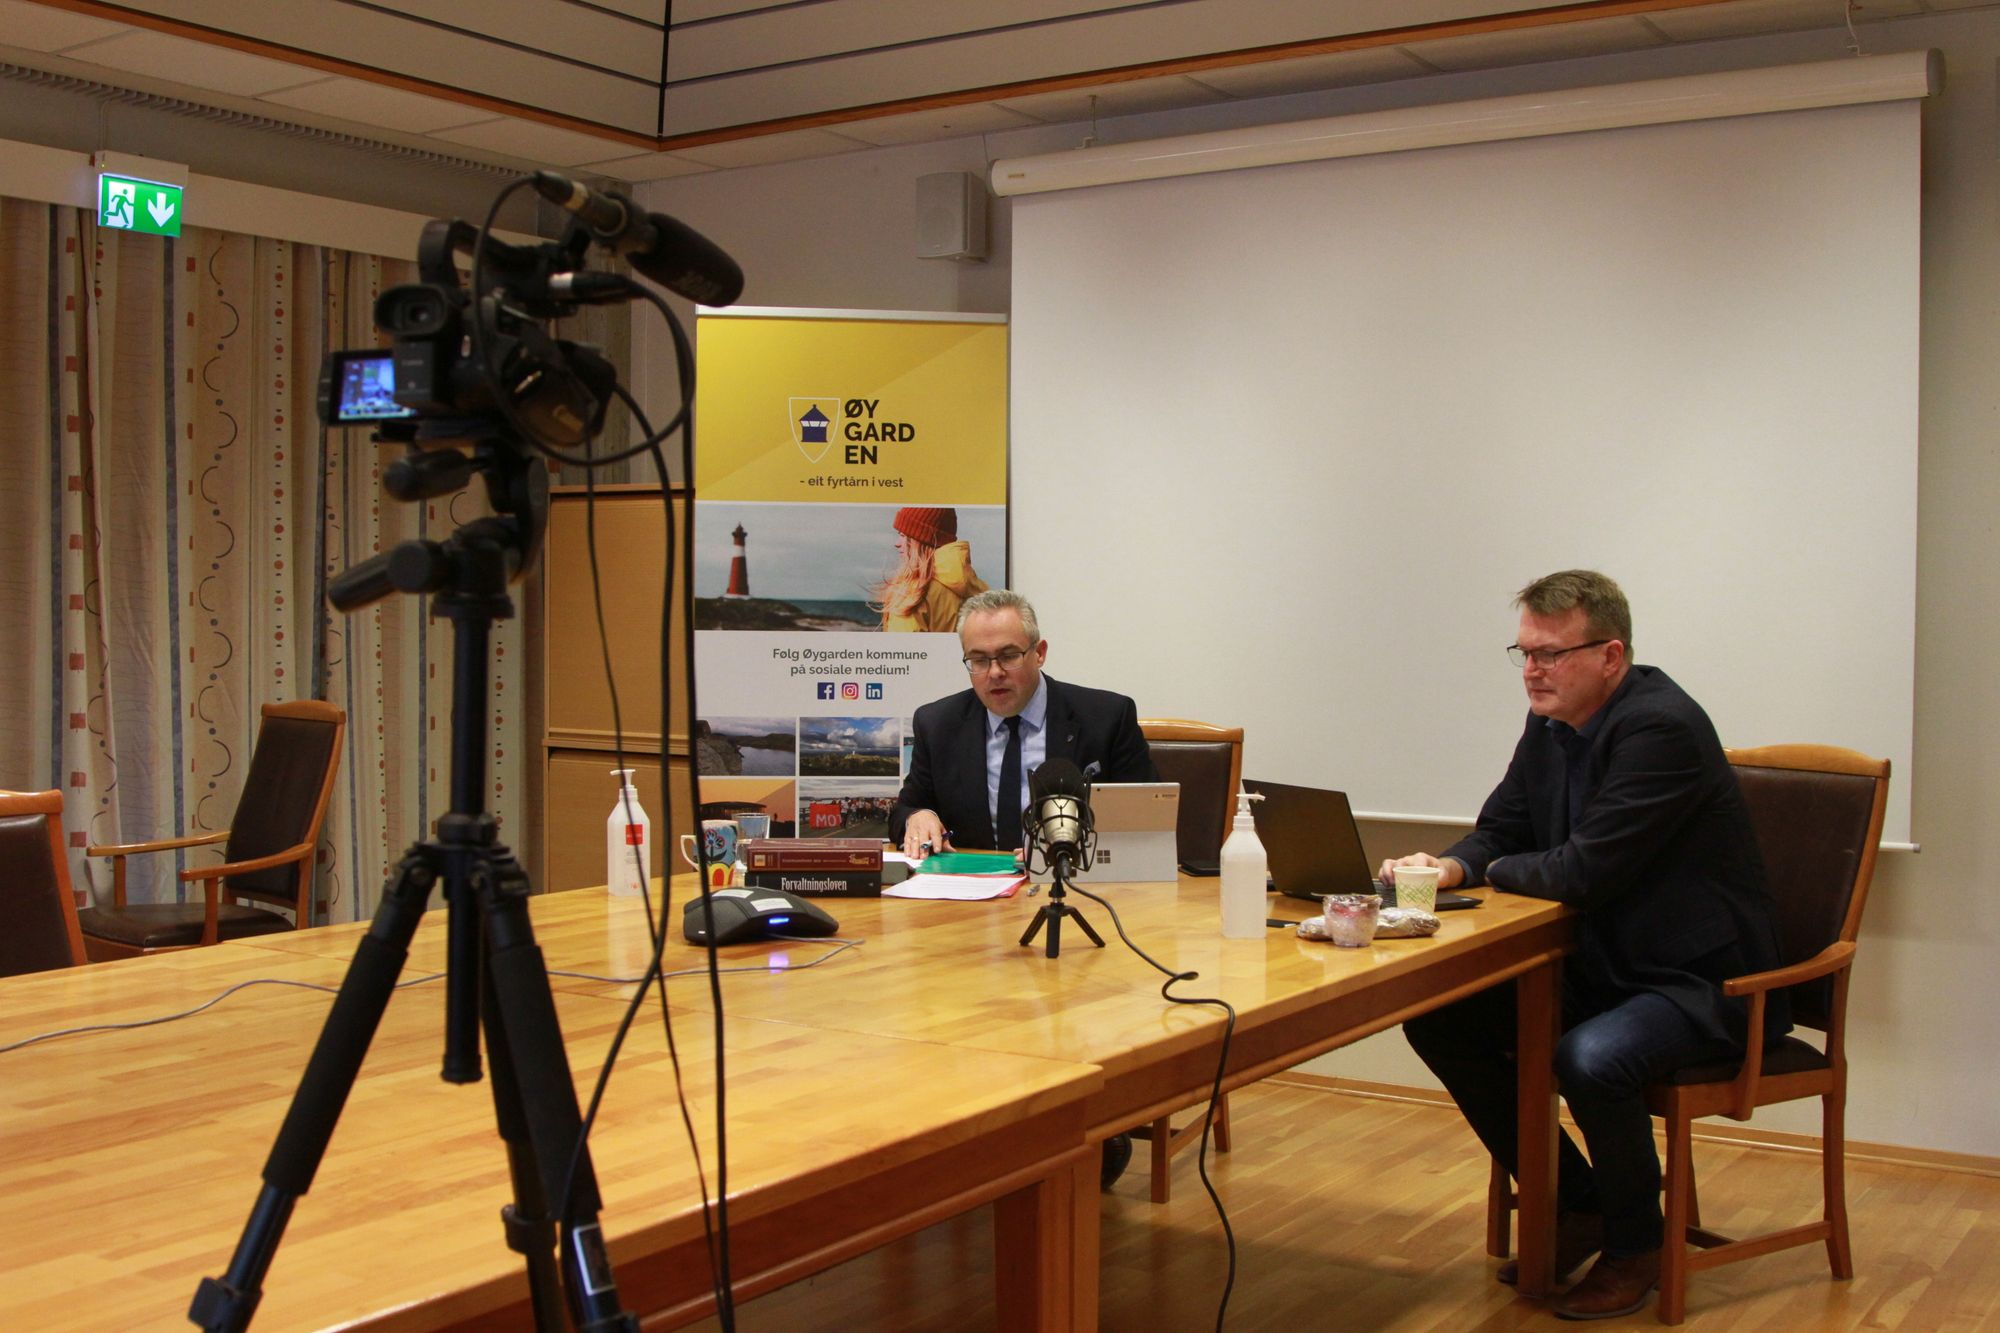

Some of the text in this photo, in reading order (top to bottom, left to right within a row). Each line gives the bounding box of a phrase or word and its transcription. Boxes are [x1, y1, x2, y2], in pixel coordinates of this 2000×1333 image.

[844, 399, 879, 418] ØY
[844, 422, 915, 442] GARD
[845, 445, 878, 464] EN
[808, 476, 823, 486] eit
[827, 475, 868, 488] fyrtårn
[878, 477, 903, 487] vest
[773, 648, 927, 661] Følg Øygarden kommune
[790, 665, 909, 676] på sosiale medium!
[781, 877, 847, 892] Forvaltningsloven
